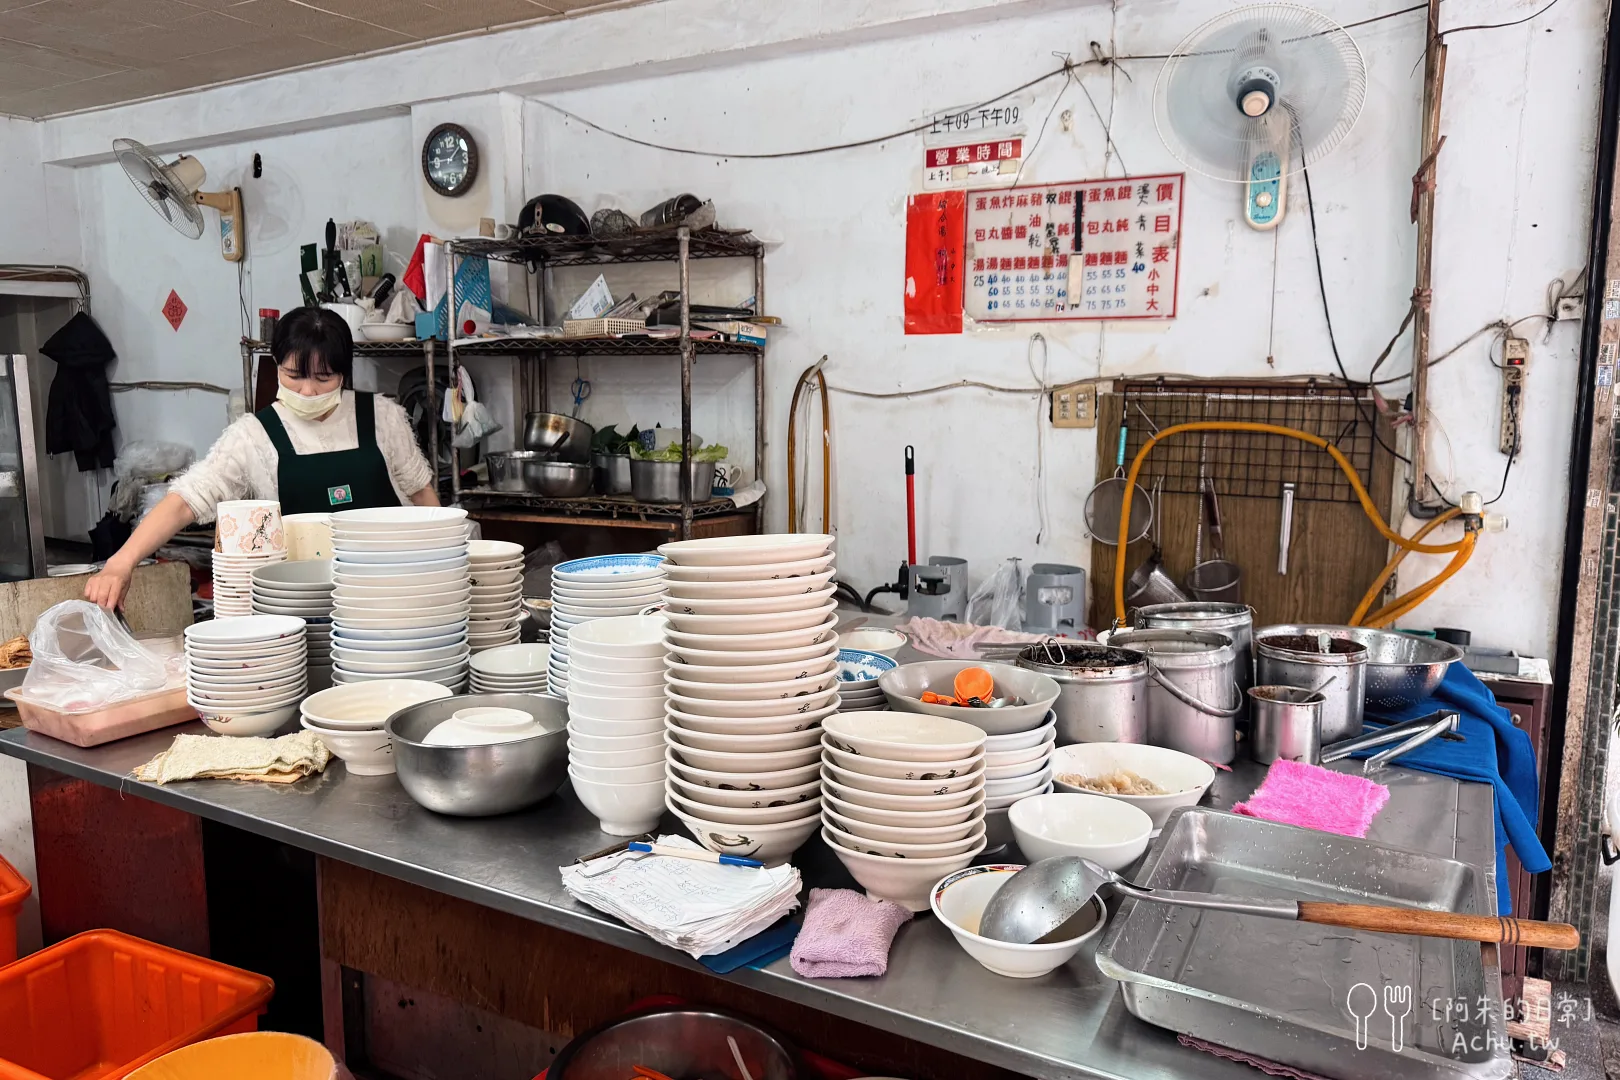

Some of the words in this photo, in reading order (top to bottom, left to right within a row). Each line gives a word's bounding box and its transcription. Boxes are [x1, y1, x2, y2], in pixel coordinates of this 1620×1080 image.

[445, 136, 454, 148] 12
[434, 157, 440, 168] 9
[462, 152, 468, 164] 3
[935, 142, 1012, 166] 營業時間
[450, 172, 456, 184] 6
[1085, 188, 1102, 266] 蛋包麵
[1100, 188, 1116, 266] 魚丸麵
[1152, 183, 1174, 263] 價目表
[973, 197, 987, 272] 蛋包湯
[986, 196, 1001, 270] 魚丸湯
[1000, 196, 1014, 271] 炸醬麵
[1014, 194, 1028, 270] 麻醬麵
[1132, 262, 1145, 273] 40
[1148, 269, 1160, 280] 小
[974, 275, 984, 286] 25
[988, 273, 998, 285] 40
[1001, 275, 1011, 283] 40
[1015, 274, 1025, 283] 40
[1029, 274, 1039, 282] 40
[1057, 272, 1067, 280] 40
[1086, 271, 1097, 280] 55
[1102, 270, 1112, 280] 55
[1116, 269, 1126, 278] 55
[988, 287, 998, 296] 60
[1002, 286, 1010, 295] 55
[1016, 286, 1024, 295] 55
[1030, 285, 1039, 294] 55
[1046, 285, 1054, 294] 55
[1057, 288, 1066, 298] 60
[1086, 286, 1097, 295] 65
[1101, 285, 1111, 294] 65
[1116, 284, 1126, 293] 65
[1147, 284, 1159, 296] 中
[988, 301, 998, 310] 80
[1003, 300, 1010, 308] 65
[1016, 300, 1025, 308] 65
[1030, 298, 1040, 307] 65
[1045, 300, 1054, 308] 65
[1086, 301, 1097, 310] 75
[1101, 300, 1112, 310] 75
[1116, 299, 1126, 308] 75
[1146, 298, 1158, 310] 大
